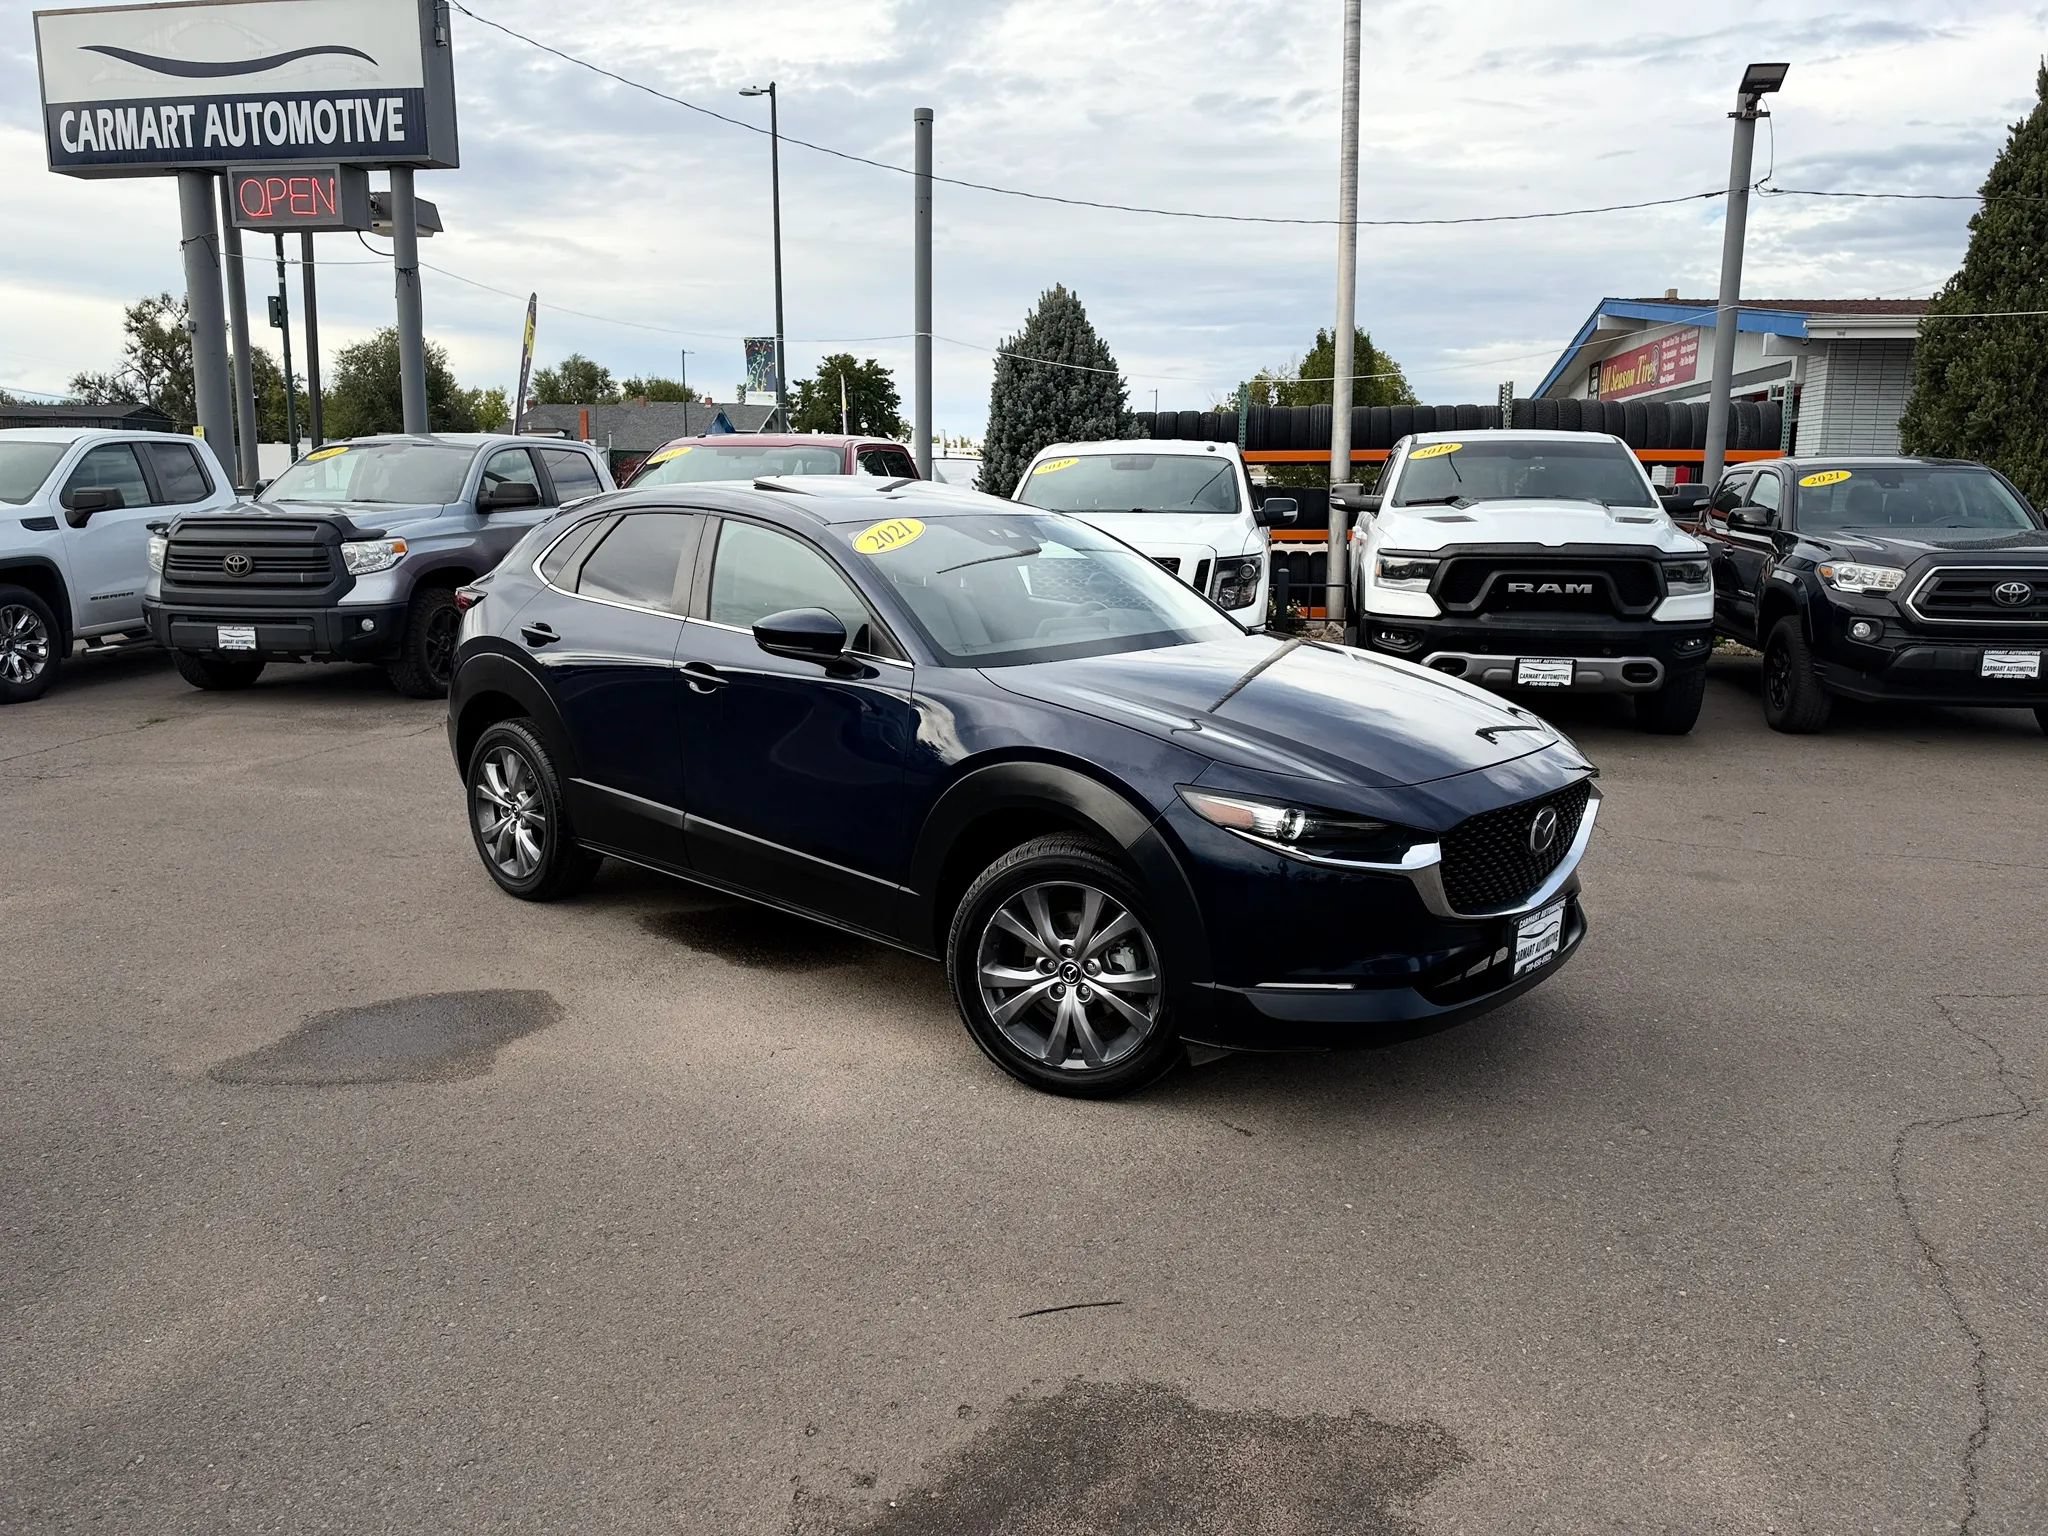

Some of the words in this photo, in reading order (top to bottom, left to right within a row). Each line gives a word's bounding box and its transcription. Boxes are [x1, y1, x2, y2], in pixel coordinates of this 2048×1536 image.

[60, 104, 196, 153] CARMART
[204, 97, 406, 148] AUTOMOTIVE
[239, 177, 336, 217] OPEN
[1600, 364, 1612, 394] All
[1610, 364, 1635, 392] Season
[1809, 471, 1840, 485] 2021
[866, 521, 913, 549] 2021
[90, 591, 134, 601] SIERRA
[1507, 582, 1593, 594] RAM
[1541, 673, 1570, 681] AUTOMOTIVE
[2006, 665, 2037, 673] AUTOMOTIVE
[1518, 911, 1541, 930] CARMART
[1535, 929, 1559, 954] AUTOMOTIVE
